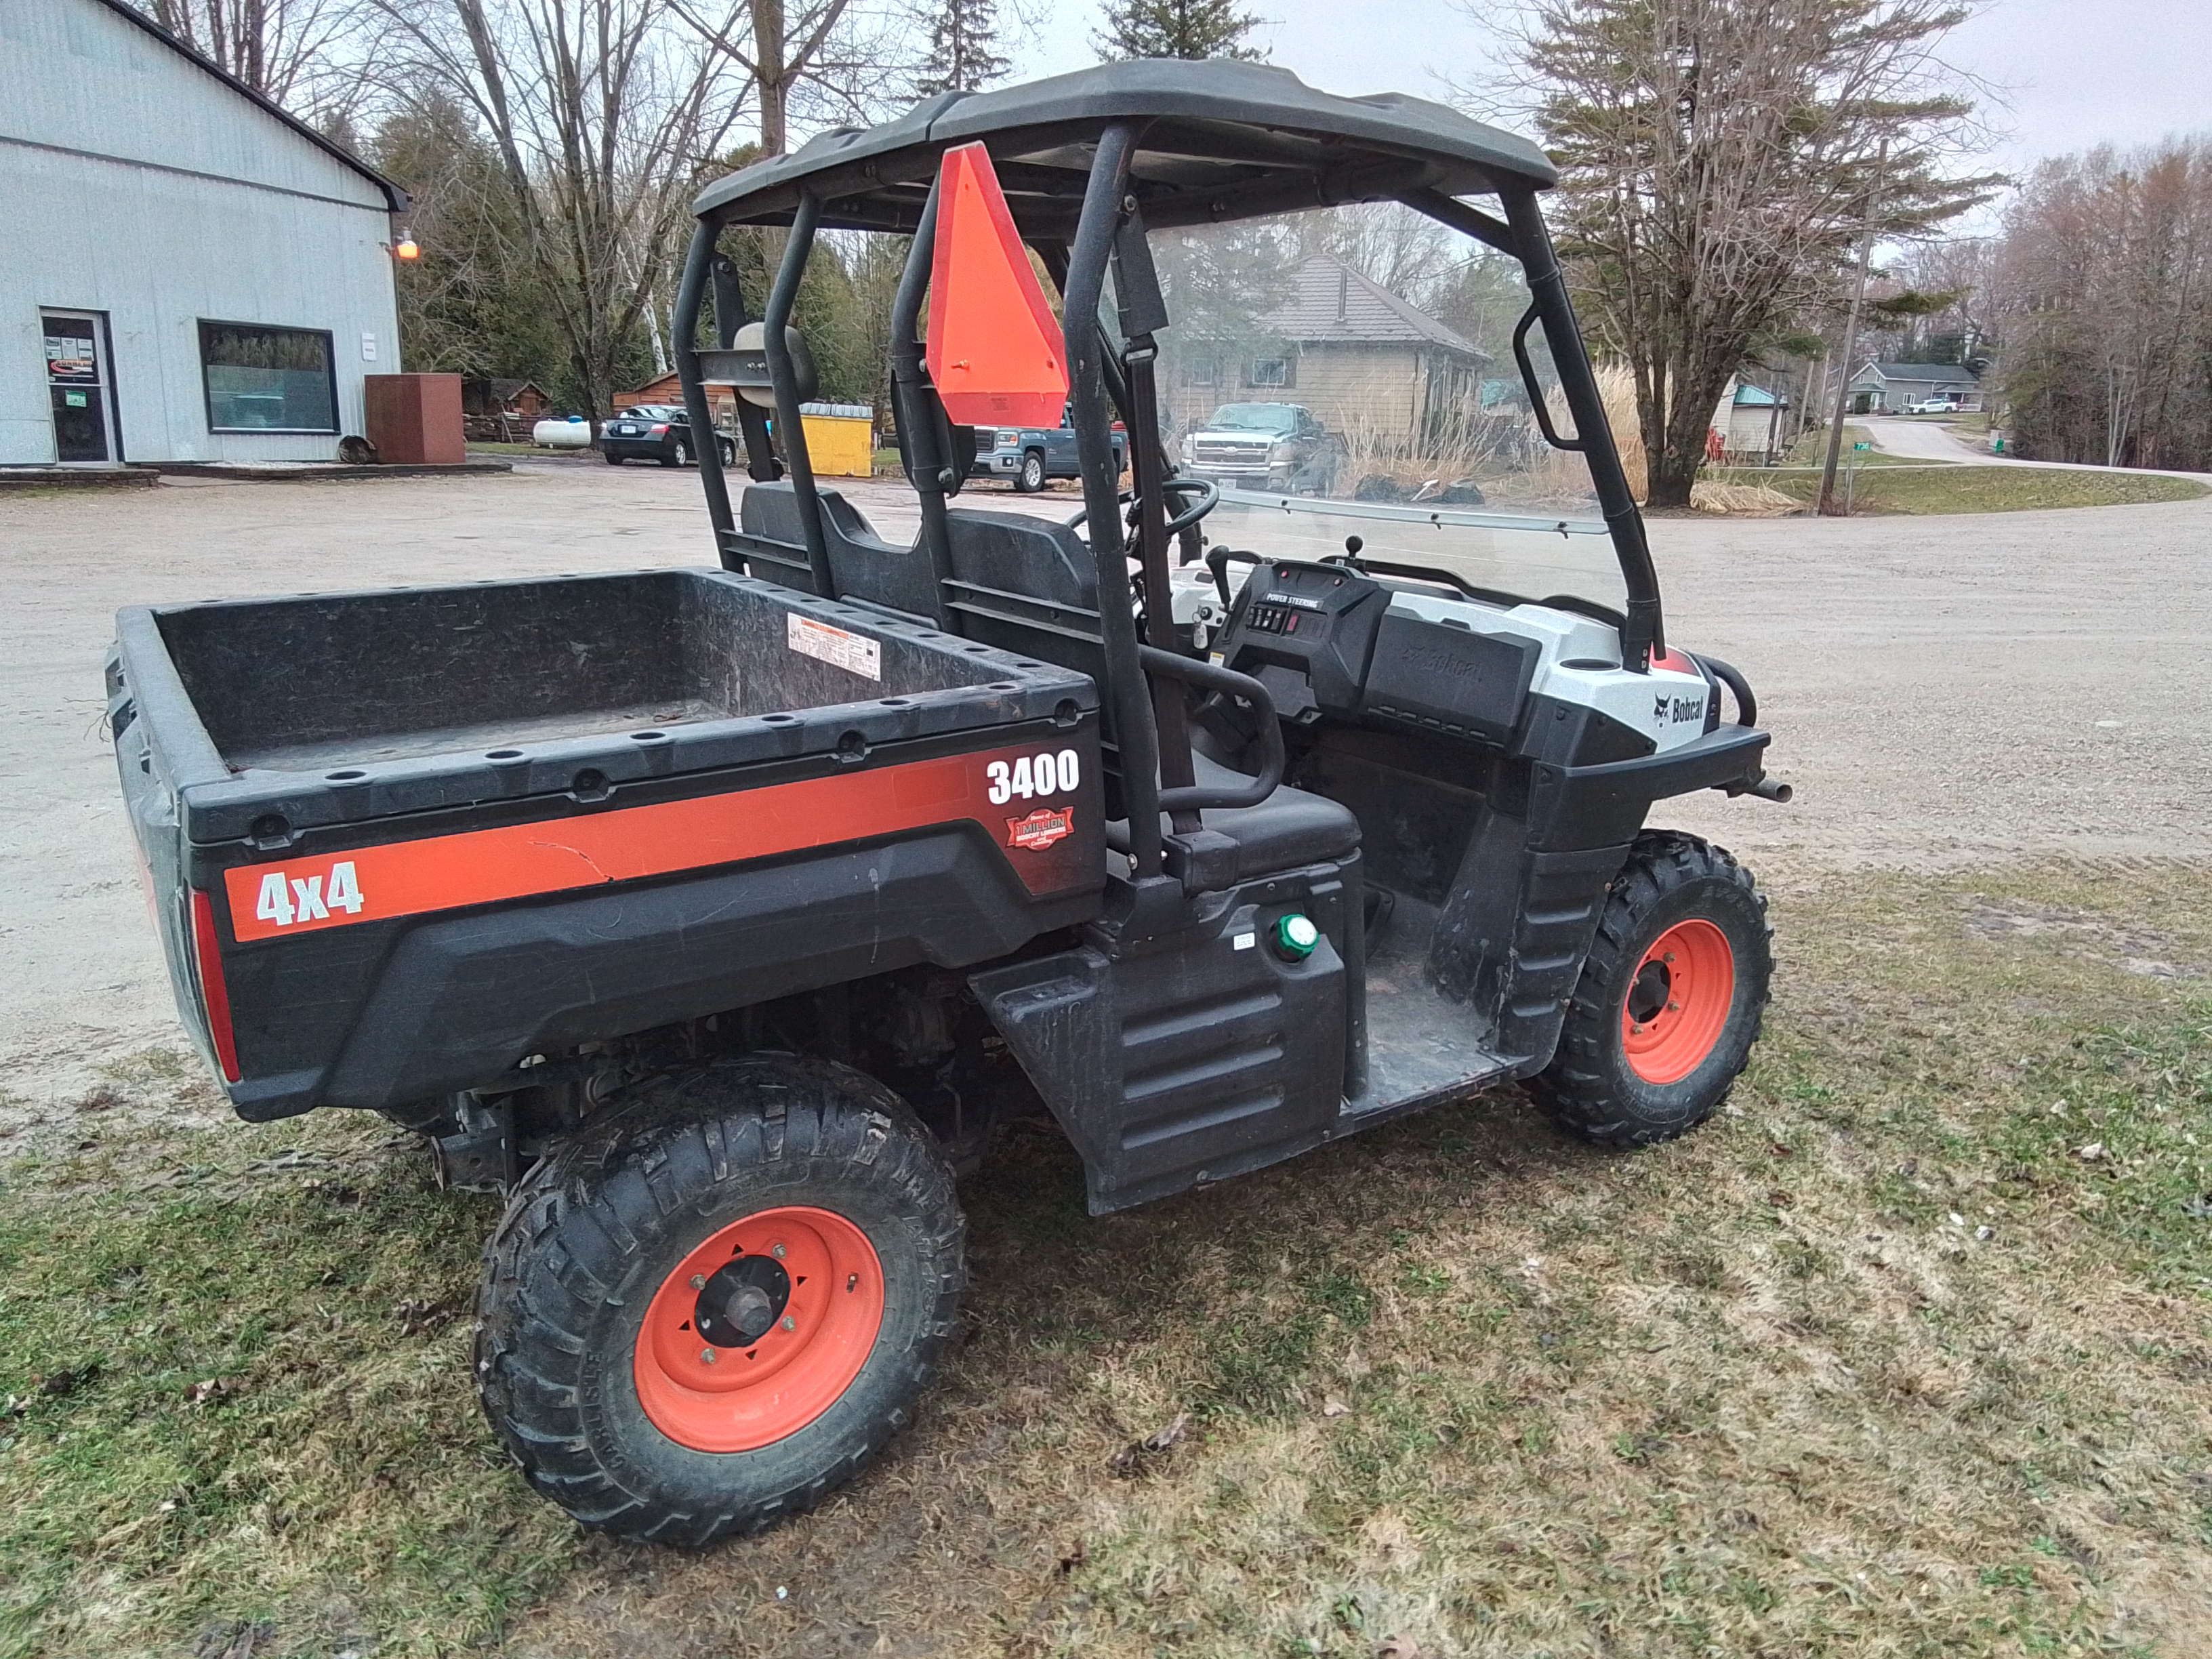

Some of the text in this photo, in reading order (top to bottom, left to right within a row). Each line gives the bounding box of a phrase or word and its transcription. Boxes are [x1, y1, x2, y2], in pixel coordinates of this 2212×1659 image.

[1267, 593, 1318, 608] POWER STEERING
[1671, 695, 1704, 723] Bobcat
[987, 749, 1080, 804] 3400
[1023, 817, 1065, 834] MILLION
[257, 861, 365, 926] 4x4
[583, 1351, 625, 1469] CARLISLE
